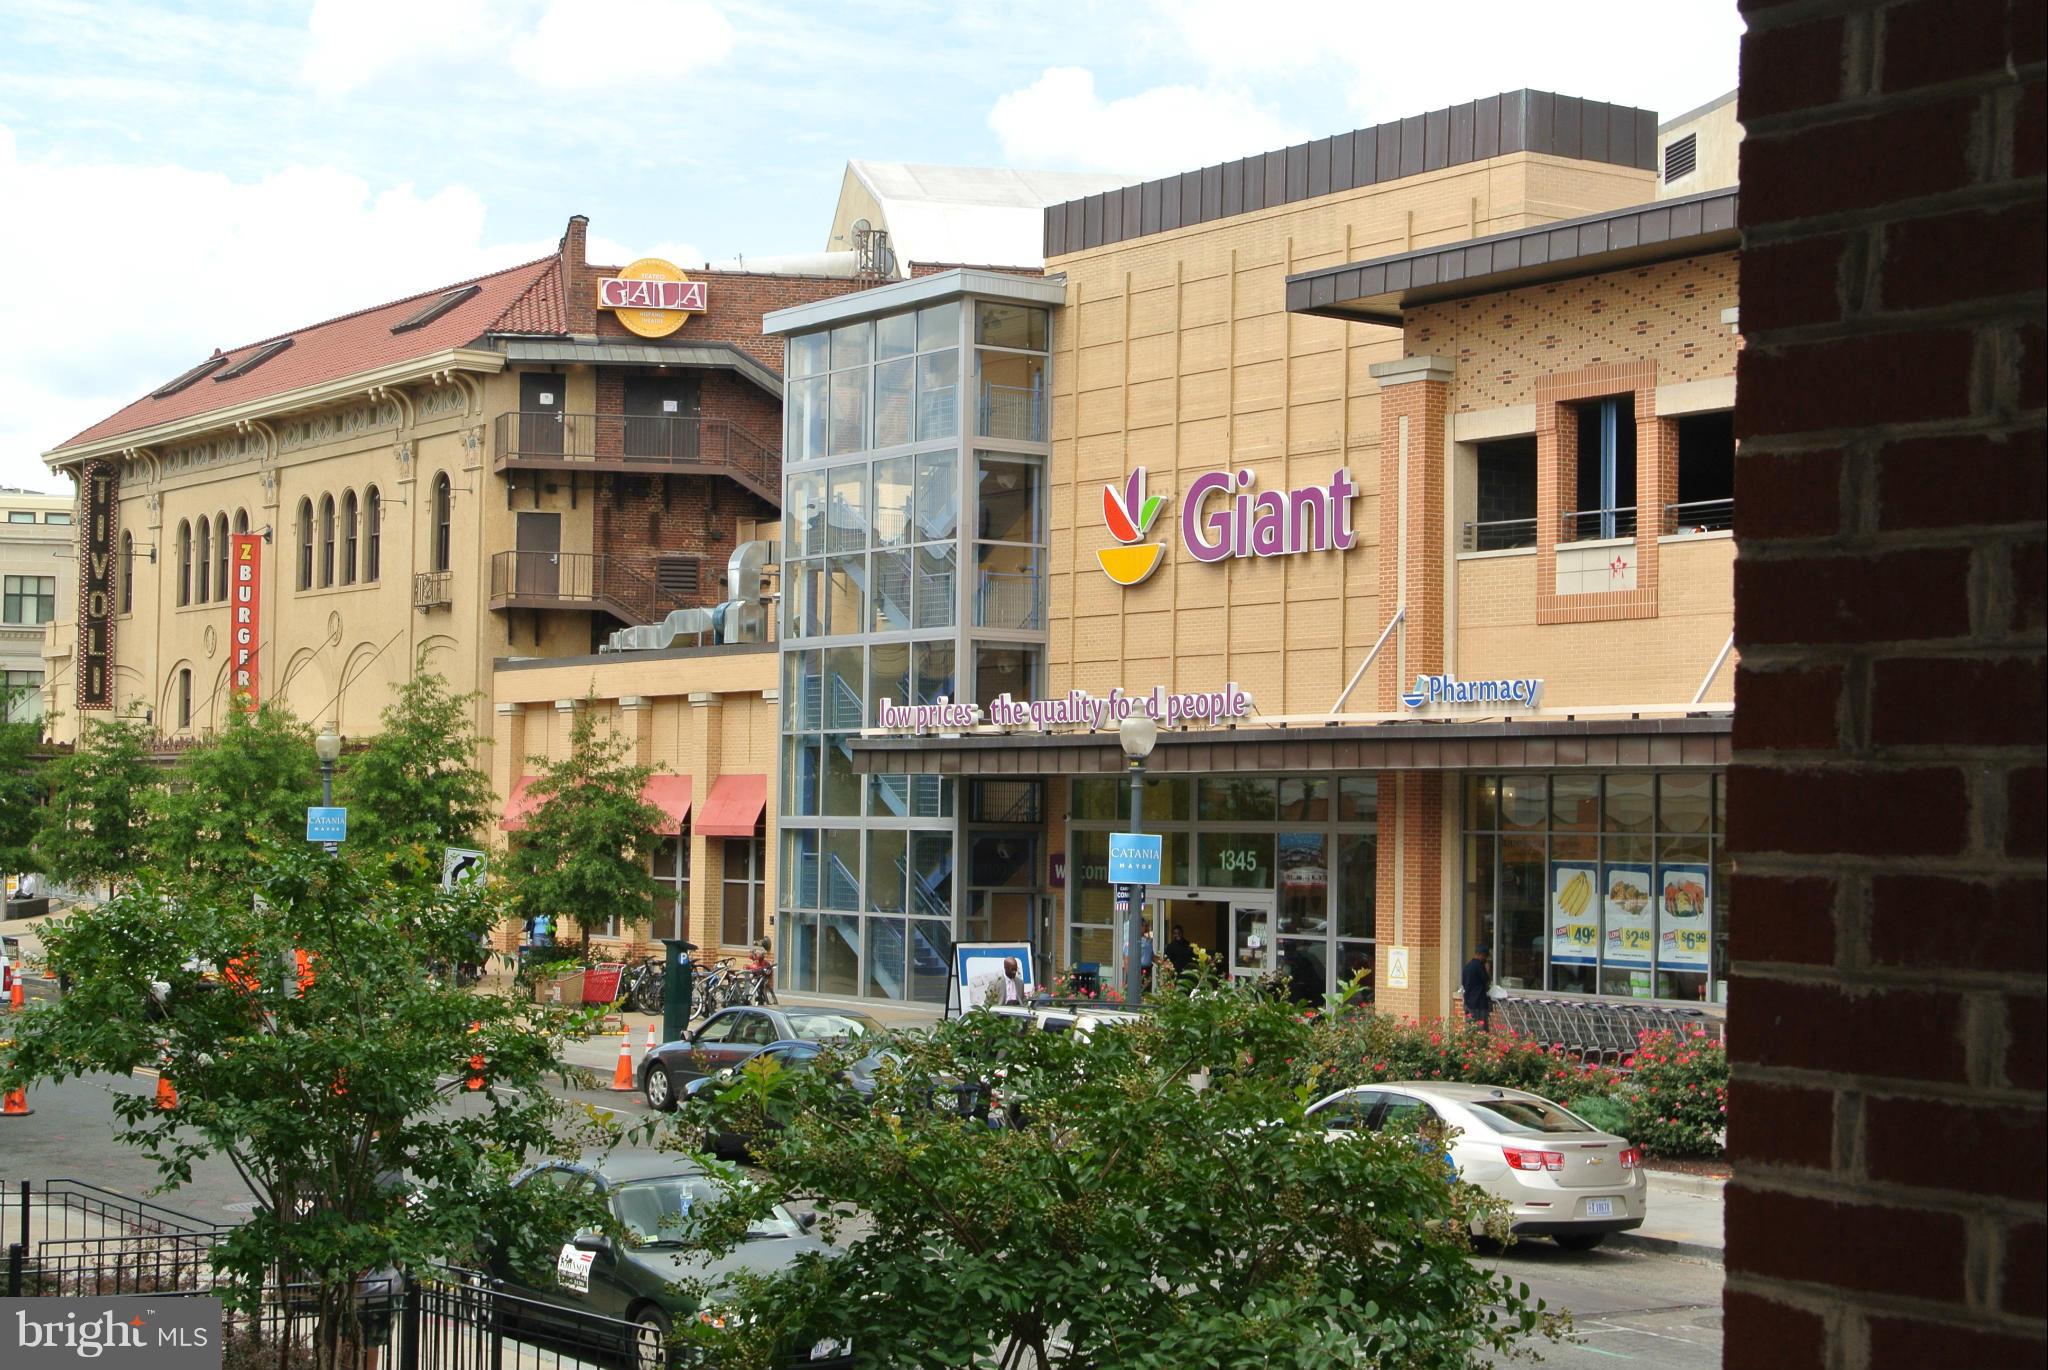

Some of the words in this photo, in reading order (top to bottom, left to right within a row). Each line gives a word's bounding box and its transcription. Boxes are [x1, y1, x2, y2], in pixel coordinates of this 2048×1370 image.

[602, 280, 703, 309] GALA
[1182, 467, 1358, 562] Giant
[89, 475, 110, 695] TIVOLI
[1429, 675, 1537, 706] Pharmacy
[880, 698, 912, 728] low
[915, 696, 973, 735] prices
[990, 693, 1024, 725] the
[1029, 690, 1102, 732] quality
[1108, 687, 1159, 720] fod
[1167, 682, 1245, 727] people
[1111, 847, 1160, 860] CATANIA
[1119, 862, 1152, 870] MAYOR
[1219, 849, 1257, 871] 1345
[680, 952, 688, 964] P
